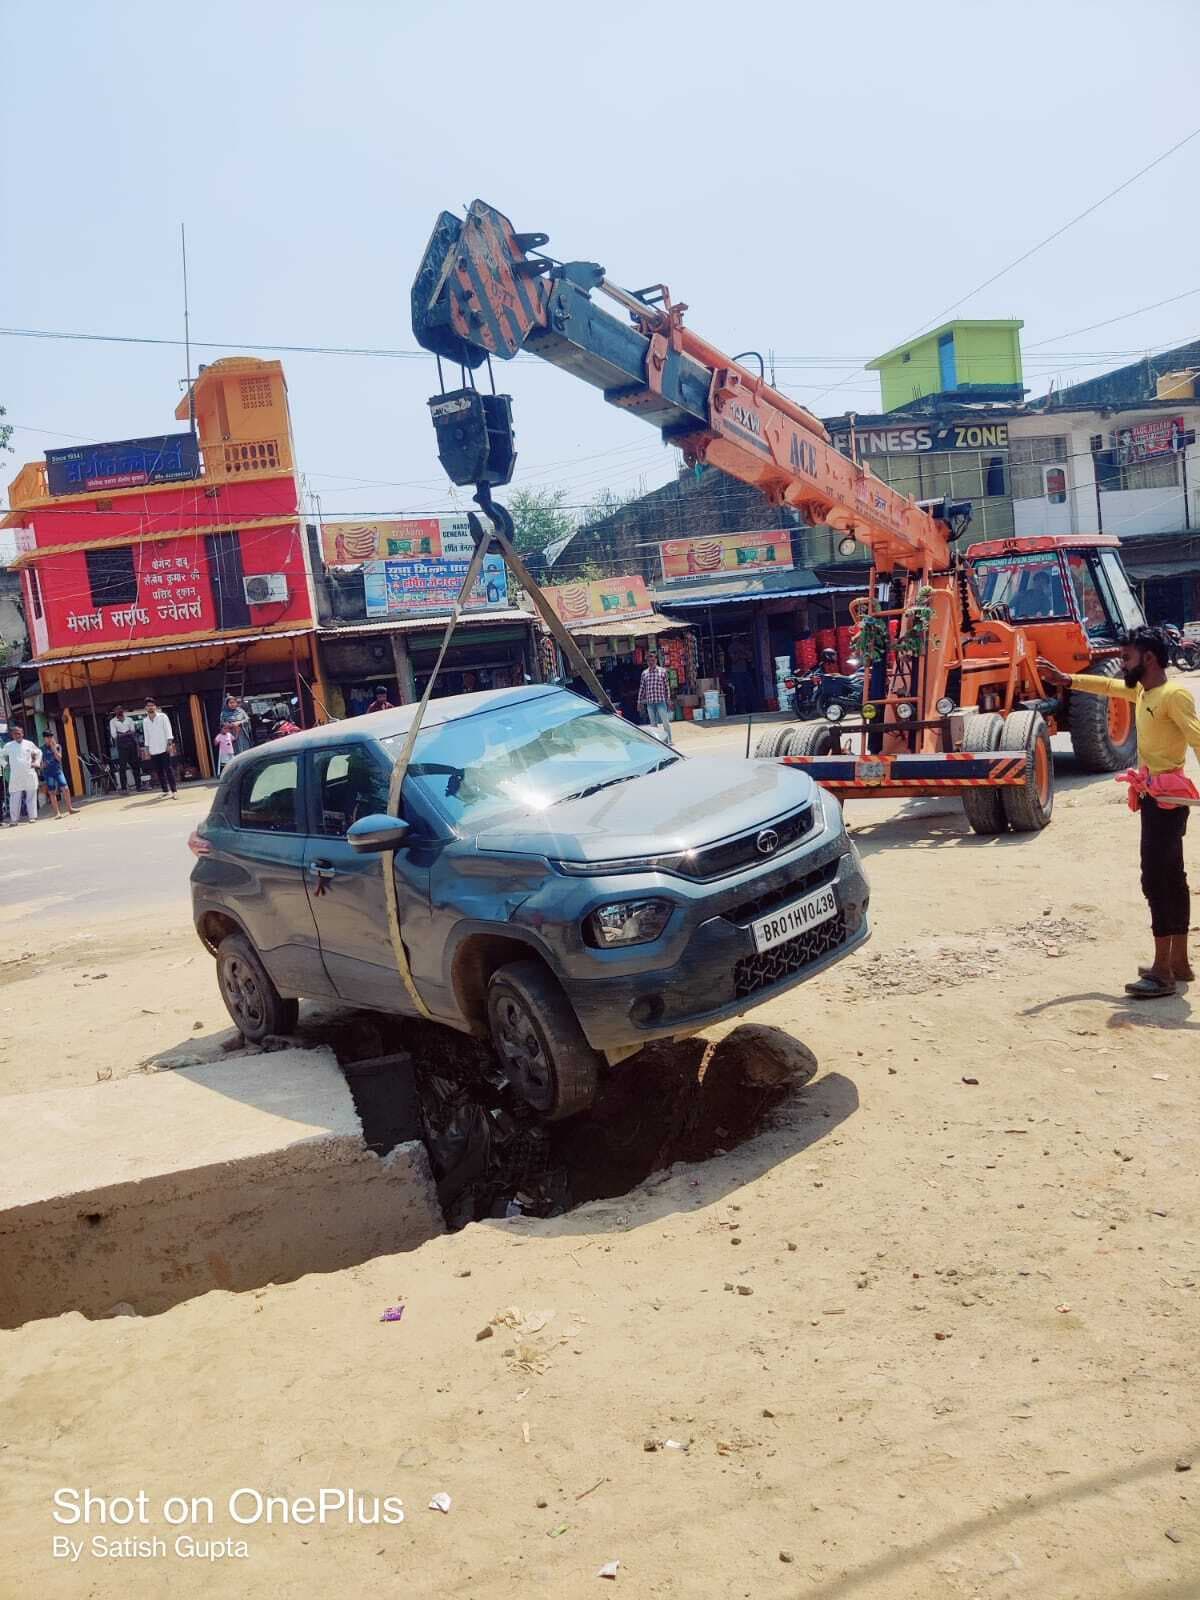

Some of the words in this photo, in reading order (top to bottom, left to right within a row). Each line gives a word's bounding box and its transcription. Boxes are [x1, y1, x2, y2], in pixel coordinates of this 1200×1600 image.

[954, 425, 1008, 448] ZONE
[66, 607, 103, 633] मेसर्स
[763, 893, 835, 942] BR01HV0438
